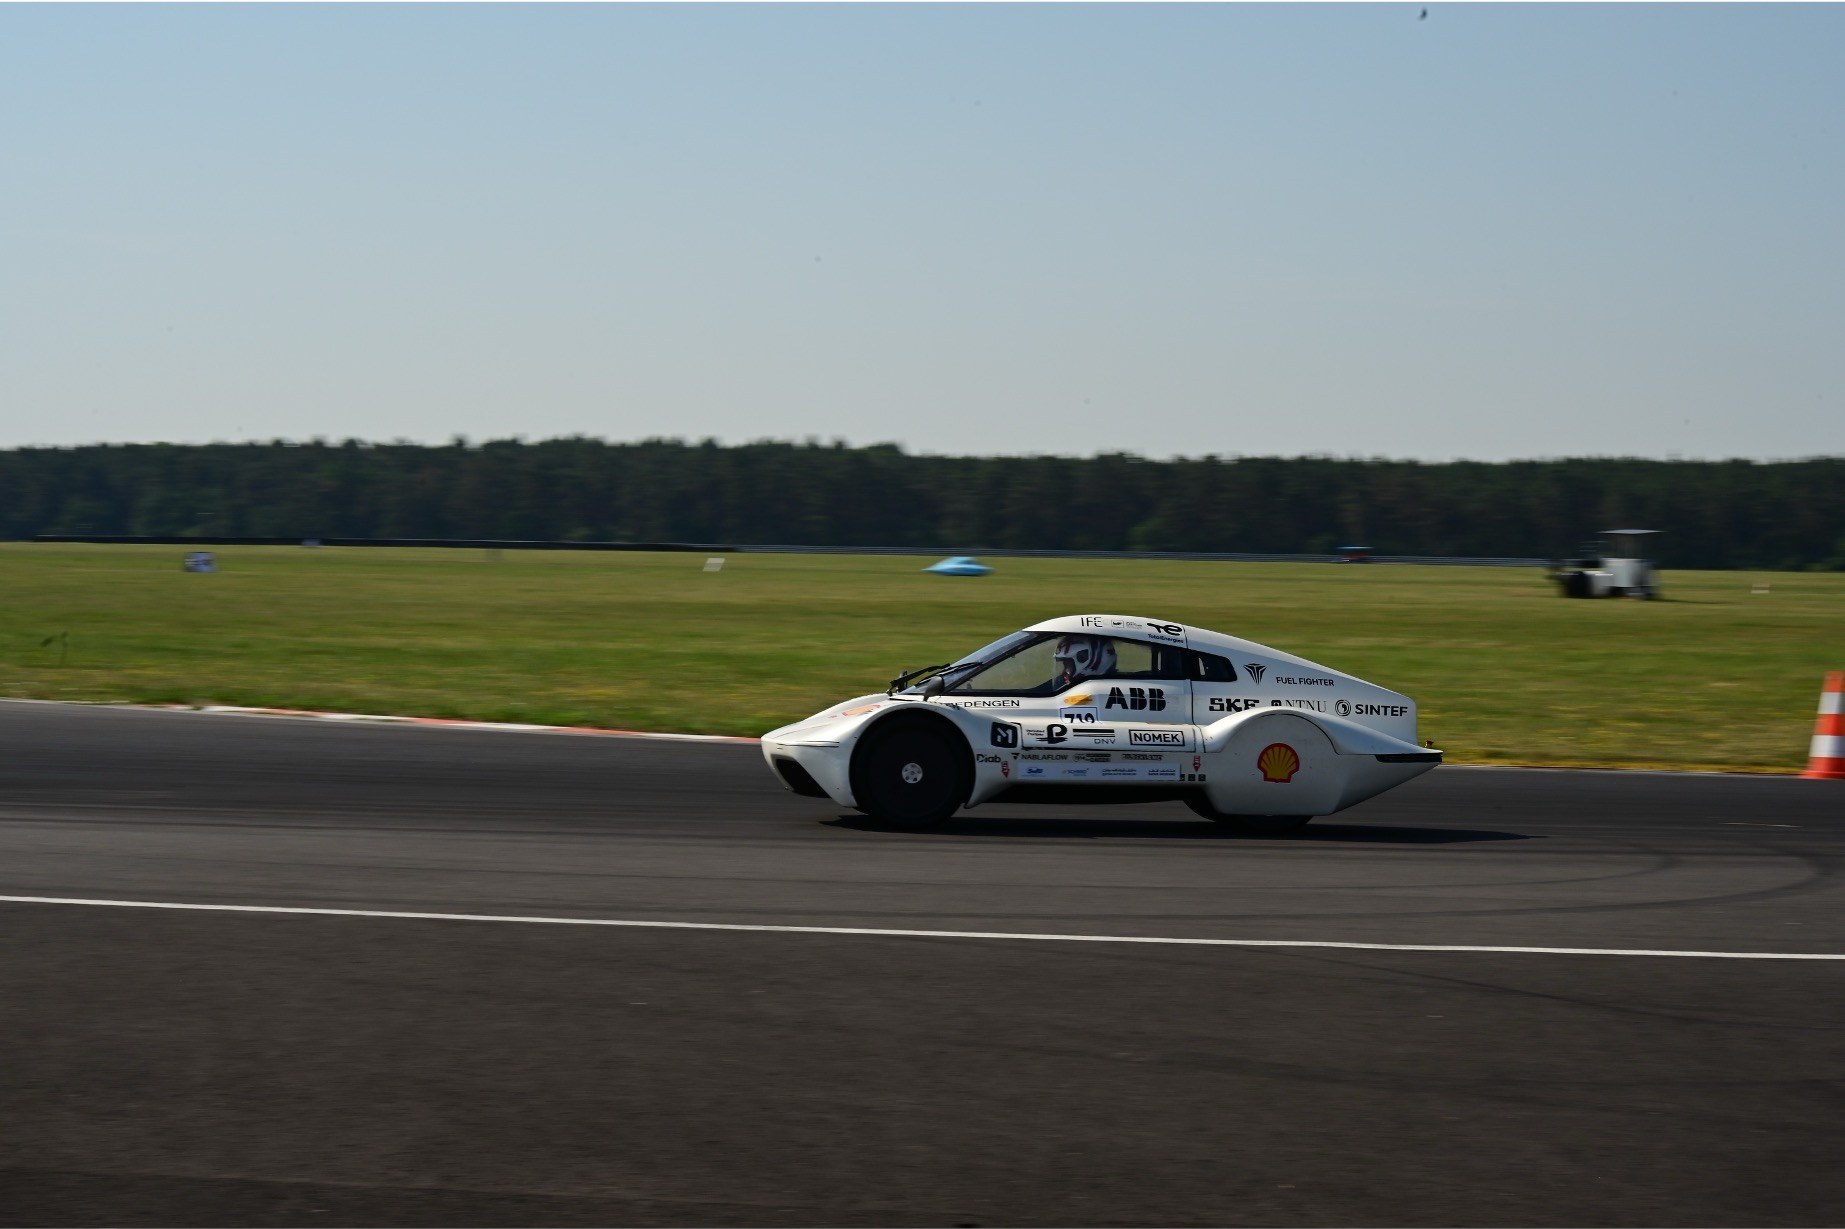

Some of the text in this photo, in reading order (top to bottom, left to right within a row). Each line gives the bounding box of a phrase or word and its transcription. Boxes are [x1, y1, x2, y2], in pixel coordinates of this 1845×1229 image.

[1080, 616, 1103, 628] IFE
[1147, 633, 1185, 644] TotalEnergies
[1275, 676, 1335, 687] FUEL FIGHTER
[1104, 686, 1167, 712] ABB
[1208, 697, 1260, 712] SKF
[1285, 699, 1327, 713] NTNU
[1355, 703, 1409, 717] SINTEF
[1133, 732, 1181, 743] NOMEK
[976, 753, 1002, 763] Diab
[1021, 753, 1069, 761] NABLAFLOW
